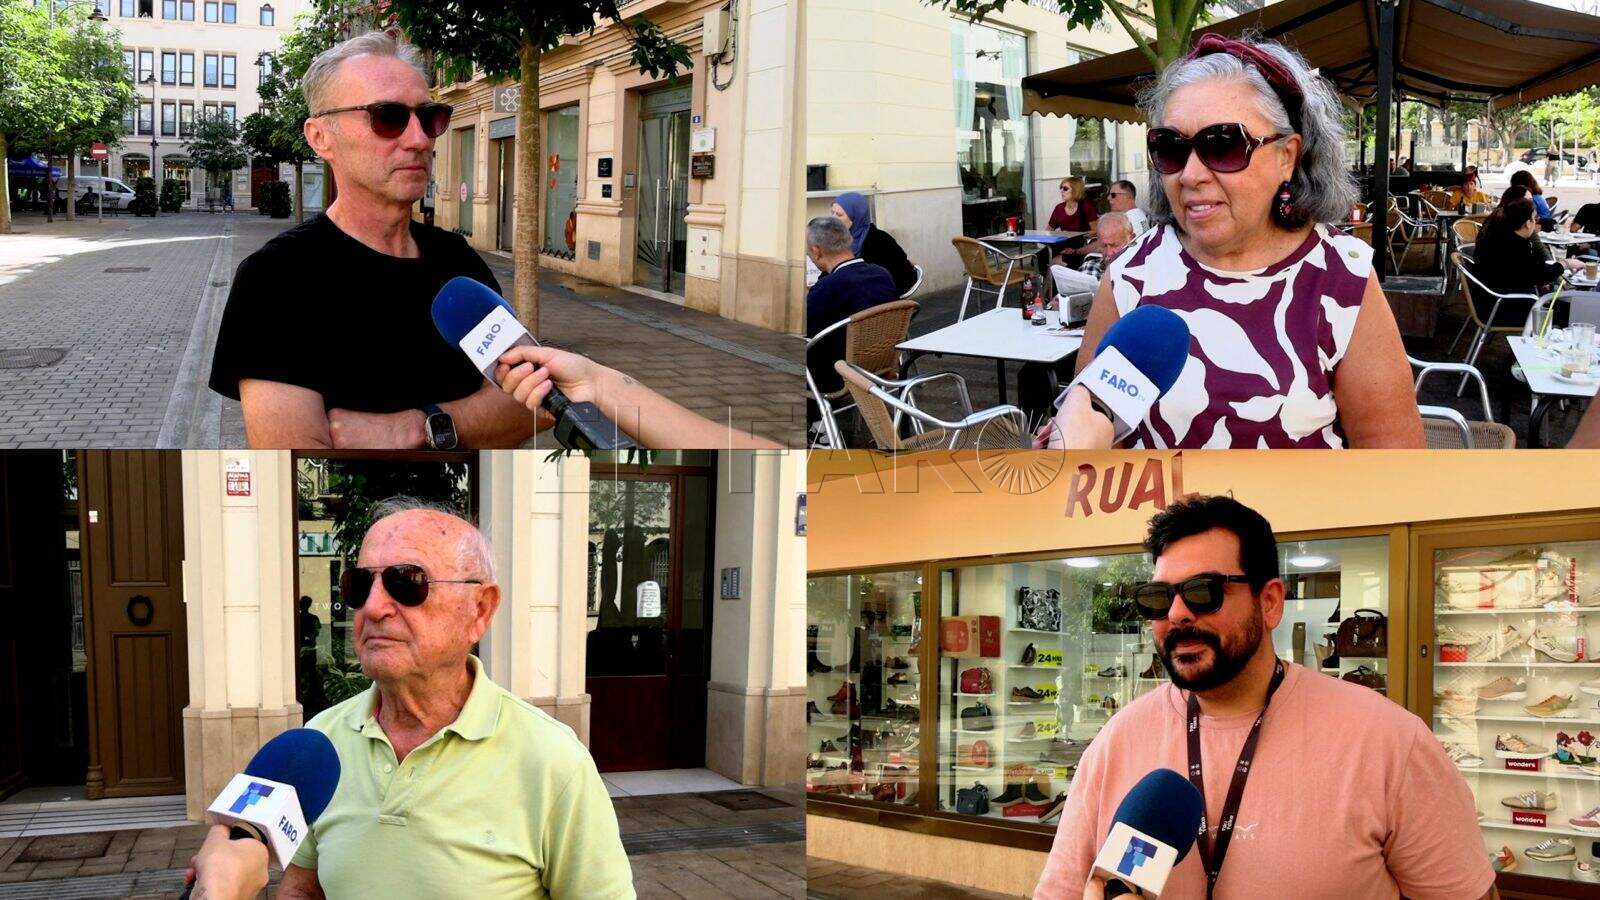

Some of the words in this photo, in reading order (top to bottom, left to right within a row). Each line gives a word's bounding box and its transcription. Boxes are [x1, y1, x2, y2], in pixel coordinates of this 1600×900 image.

[476, 324, 501, 356] FARO
[1100, 369, 1139, 397] FARO
[1038, 653, 1051, 662] 24
[279, 815, 298, 842] FARO
[1515, 816, 1544, 824] wonders
